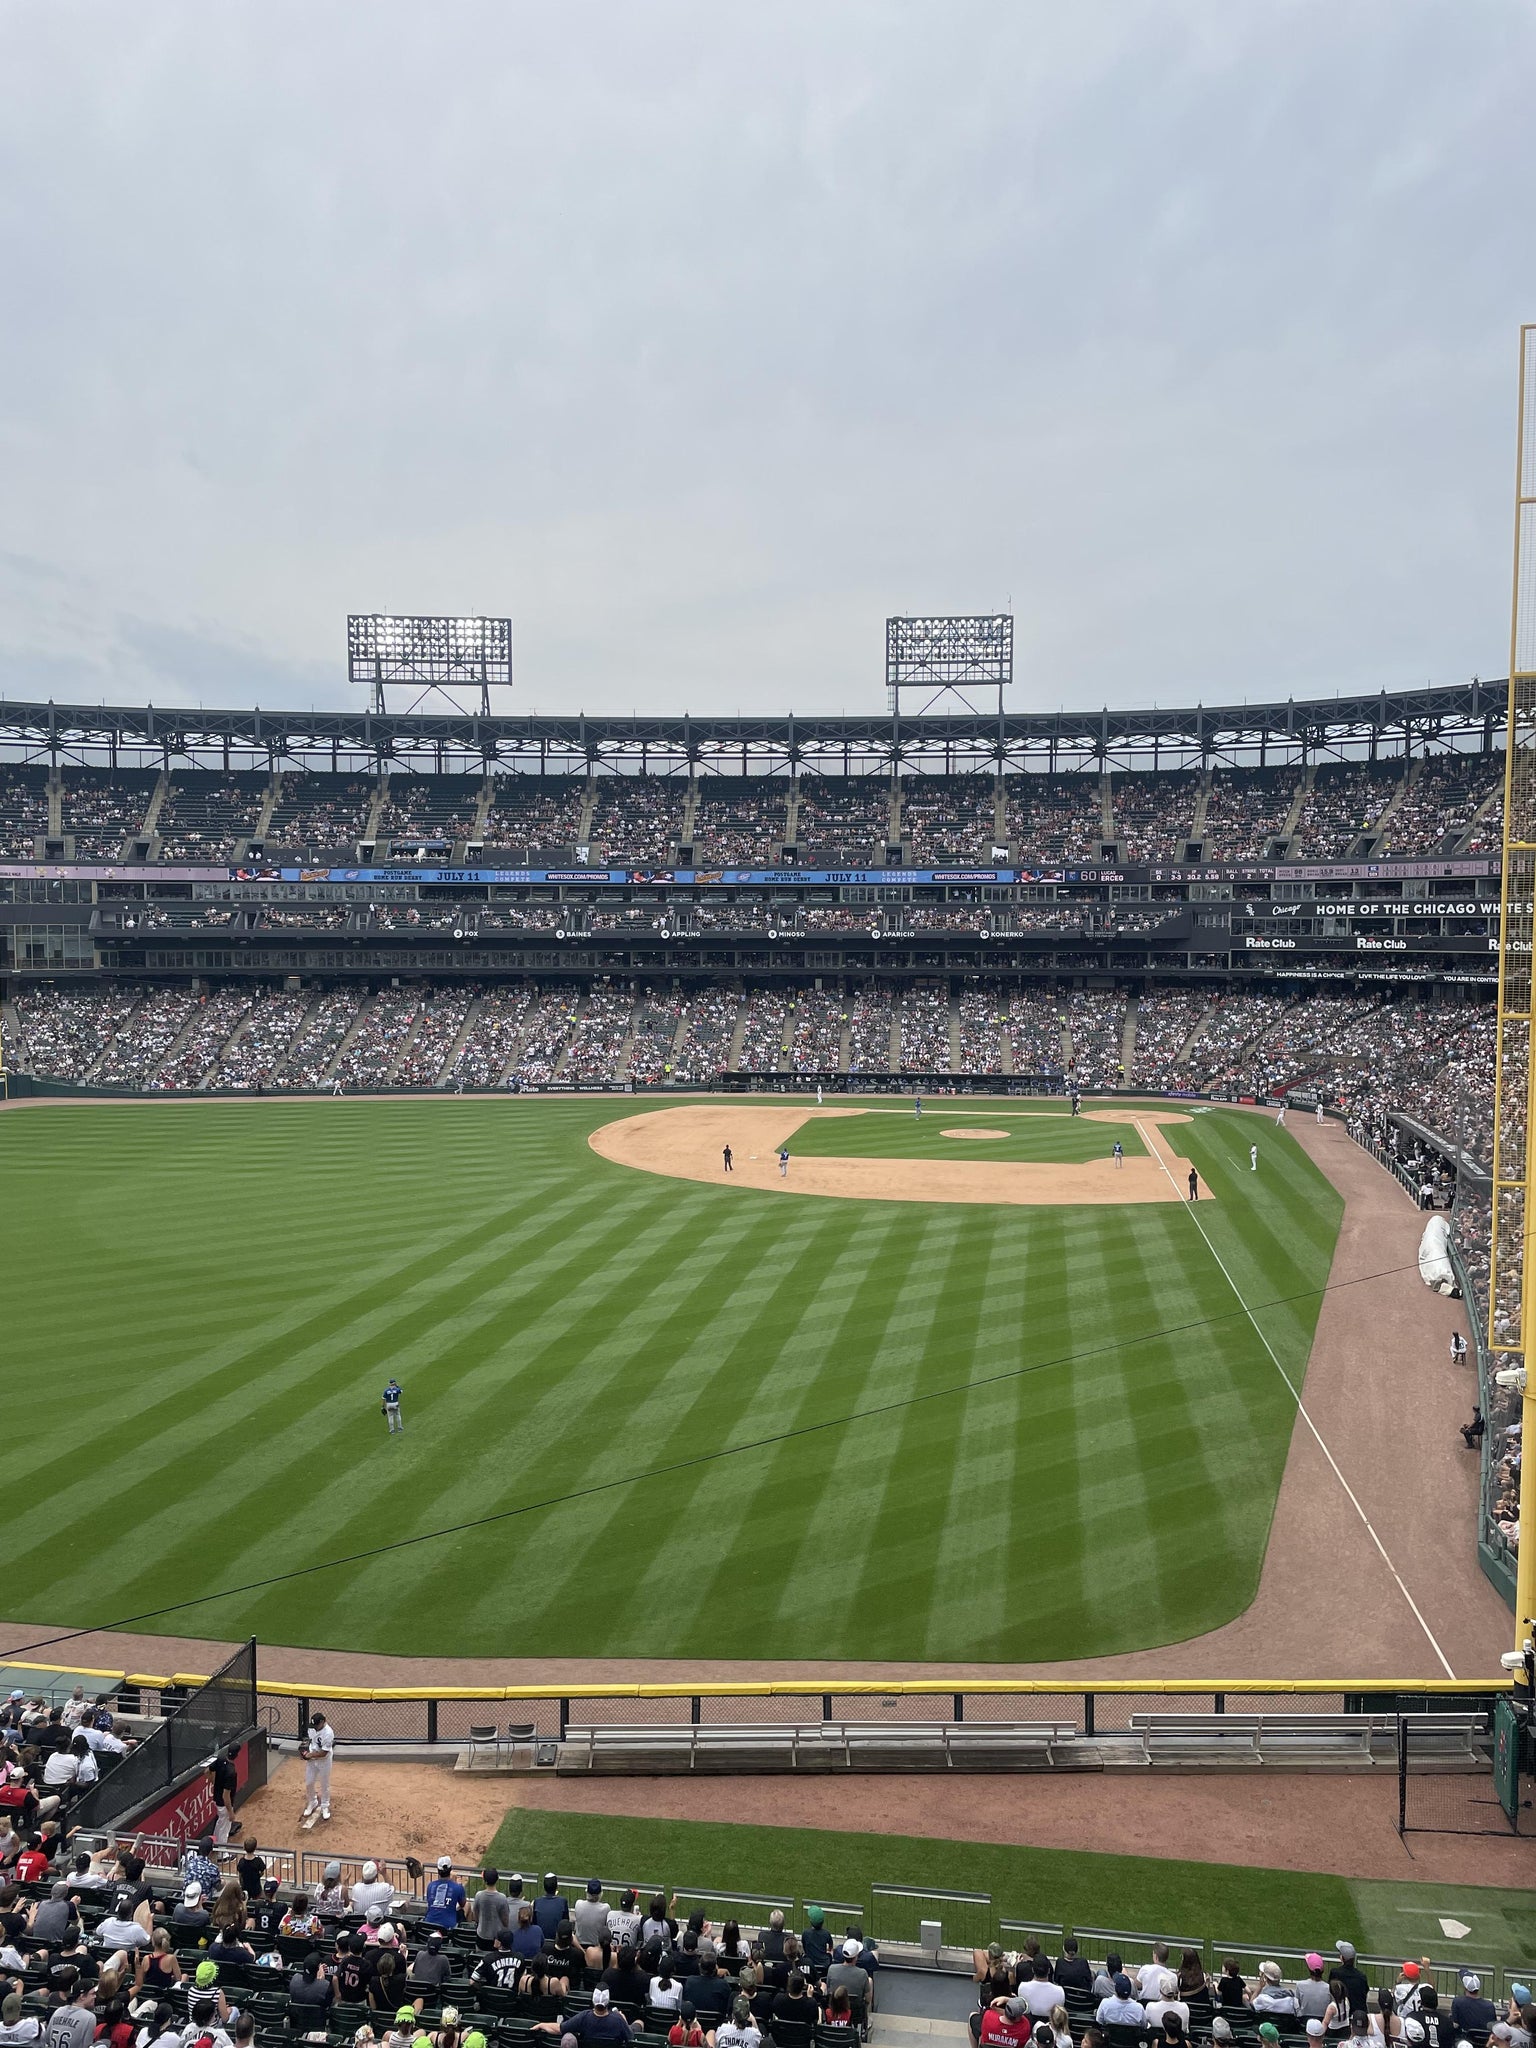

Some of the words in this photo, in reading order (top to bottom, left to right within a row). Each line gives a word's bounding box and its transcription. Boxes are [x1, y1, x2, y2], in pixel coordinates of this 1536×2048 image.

[437, 872, 464, 881] JULY
[467, 872, 480, 881] 11
[825, 874, 853, 882] JULY
[855, 874, 866, 882] 11
[1080, 871, 1097, 880] 60
[1272, 904, 1302, 916] Chicago
[1316, 905, 1355, 915] HOME
[1360, 905, 1379, 914] OF
[1384, 904, 1410, 914] THE
[1414, 904, 1476, 914] CHICAGO
[1480, 903, 1522, 914] WHTE
[1246, 938, 1270, 948] Rate
[1272, 939, 1296, 948] Club
[1357, 938, 1382, 949] Rate
[1383, 940, 1407, 949] Club
[1489, 939, 1511, 950] Rae
[174, 1778, 214, 1834] Xavie
[19, 1866, 28, 1880] 7
[116, 1884, 138, 1895] ANDERSON
[115, 1893, 128, 1912] 7
[261, 1916, 269, 1928] 8
[608, 1918, 639, 1930] BUEHRLE
[612, 1931, 630, 1946] 56
[491, 1958, 521, 1971] KONERKO
[344, 1971, 359, 1988] 10
[496, 1968, 515, 1988] 14
[53, 2017, 80, 2028] BUEHRLE
[1426, 2016, 1439, 2025] DAD
[51, 2028, 72, 2048] 56
[725, 2036, 748, 2048] THOMAS
[988, 2033, 1018, 2047] MURAKAMI
[1429, 2026, 1440, 2047] 1
